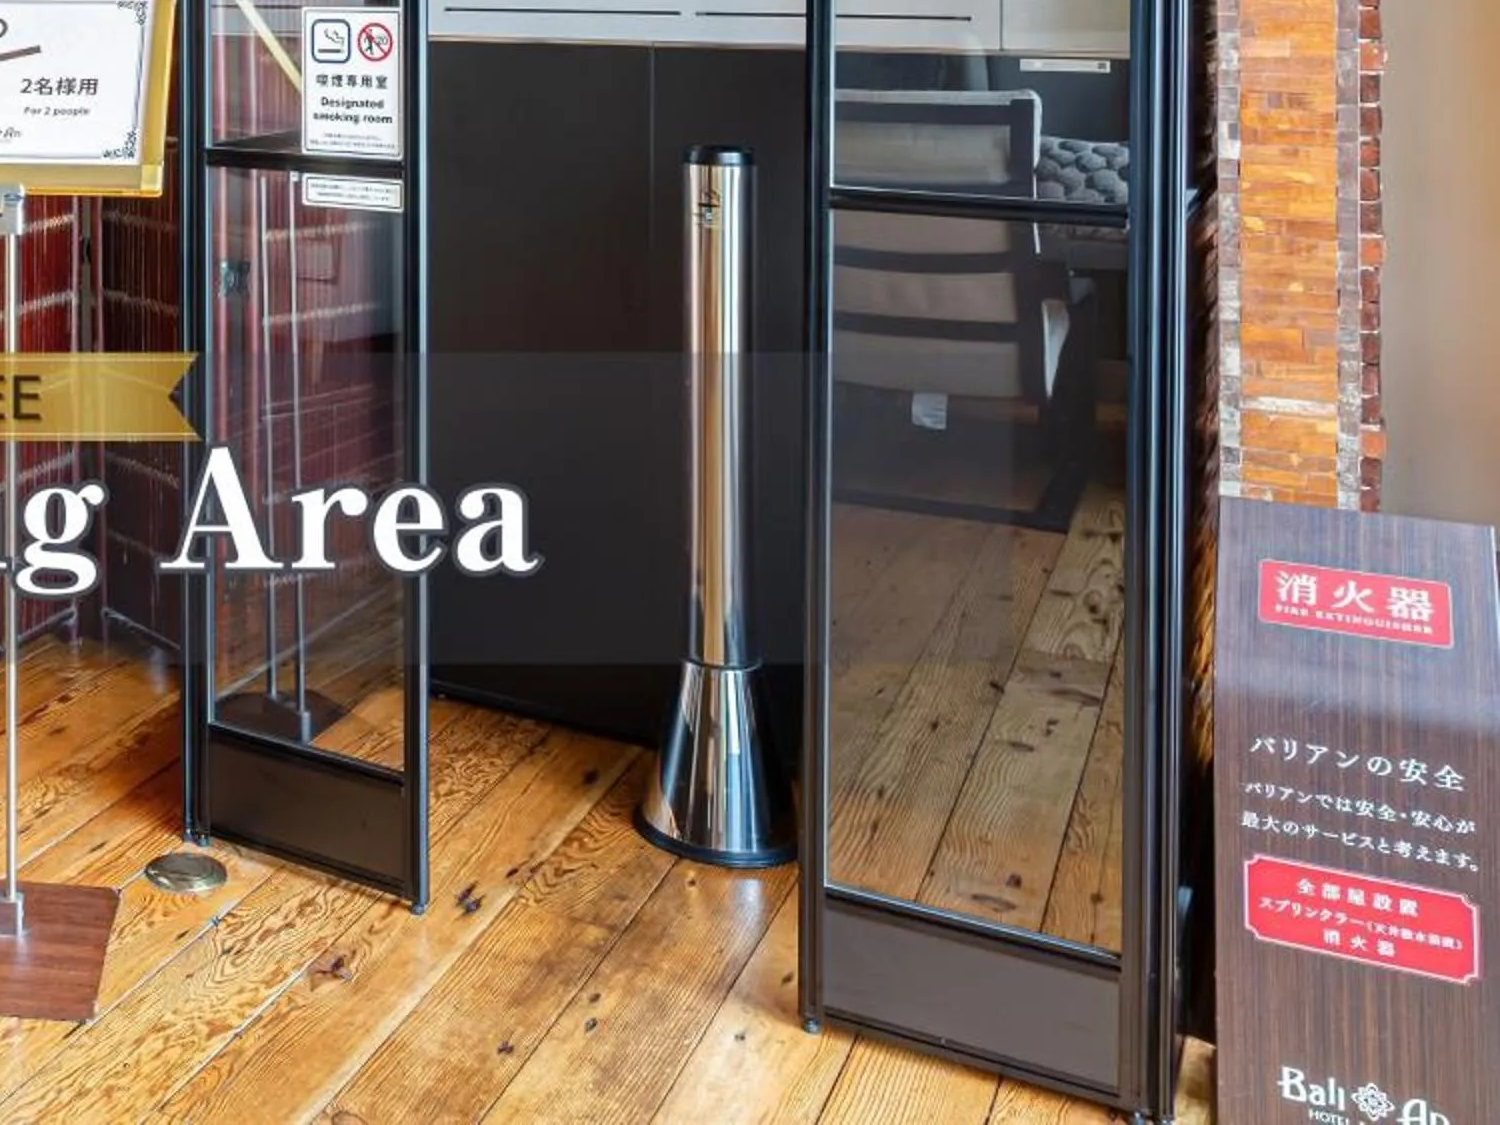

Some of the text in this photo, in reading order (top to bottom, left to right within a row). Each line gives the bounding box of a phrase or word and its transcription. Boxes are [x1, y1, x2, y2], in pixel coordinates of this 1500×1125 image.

[20, 77, 99, 96] 2名様用
[24, 105, 91, 117] For 2 people
[321, 96, 385, 110] Designated
[313, 112, 394, 125] smoking room
[1274, 570, 1434, 622] 消火器
[1250, 736, 1465, 792] バリアンの安全
[1277, 1065, 1345, 1111] Bali
